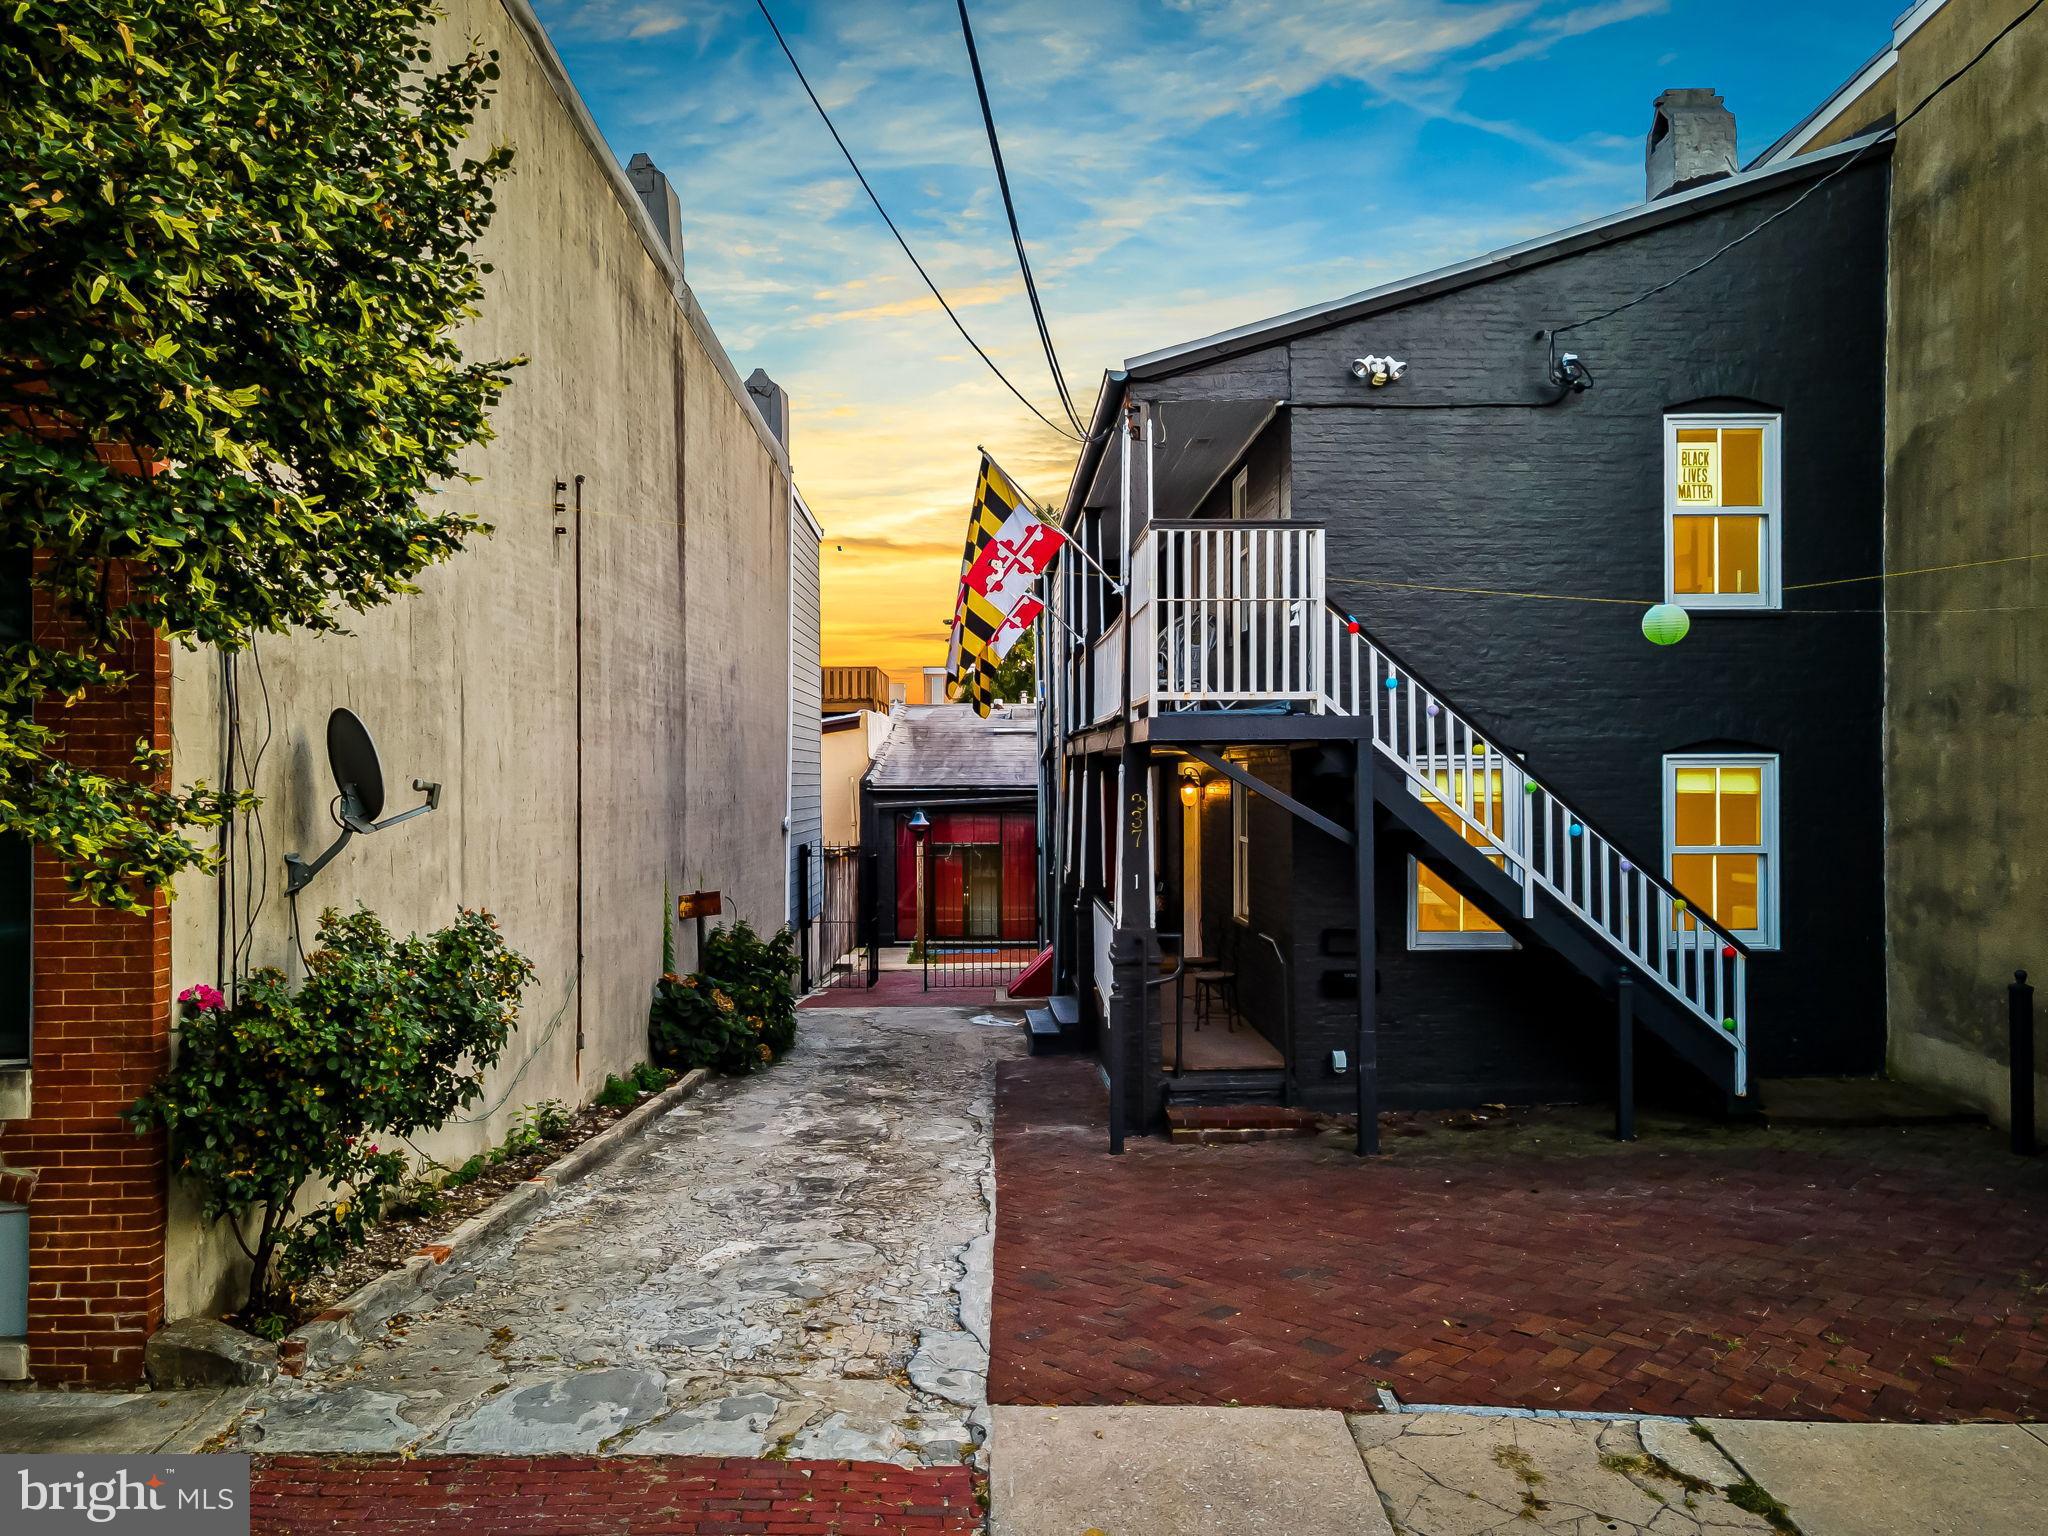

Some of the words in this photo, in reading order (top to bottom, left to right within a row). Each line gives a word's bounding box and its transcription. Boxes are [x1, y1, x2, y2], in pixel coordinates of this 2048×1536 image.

[1681, 452, 1709, 466] BLACK
[1683, 468, 1708, 483] LIVES
[1678, 484, 1713, 499] MATTER
